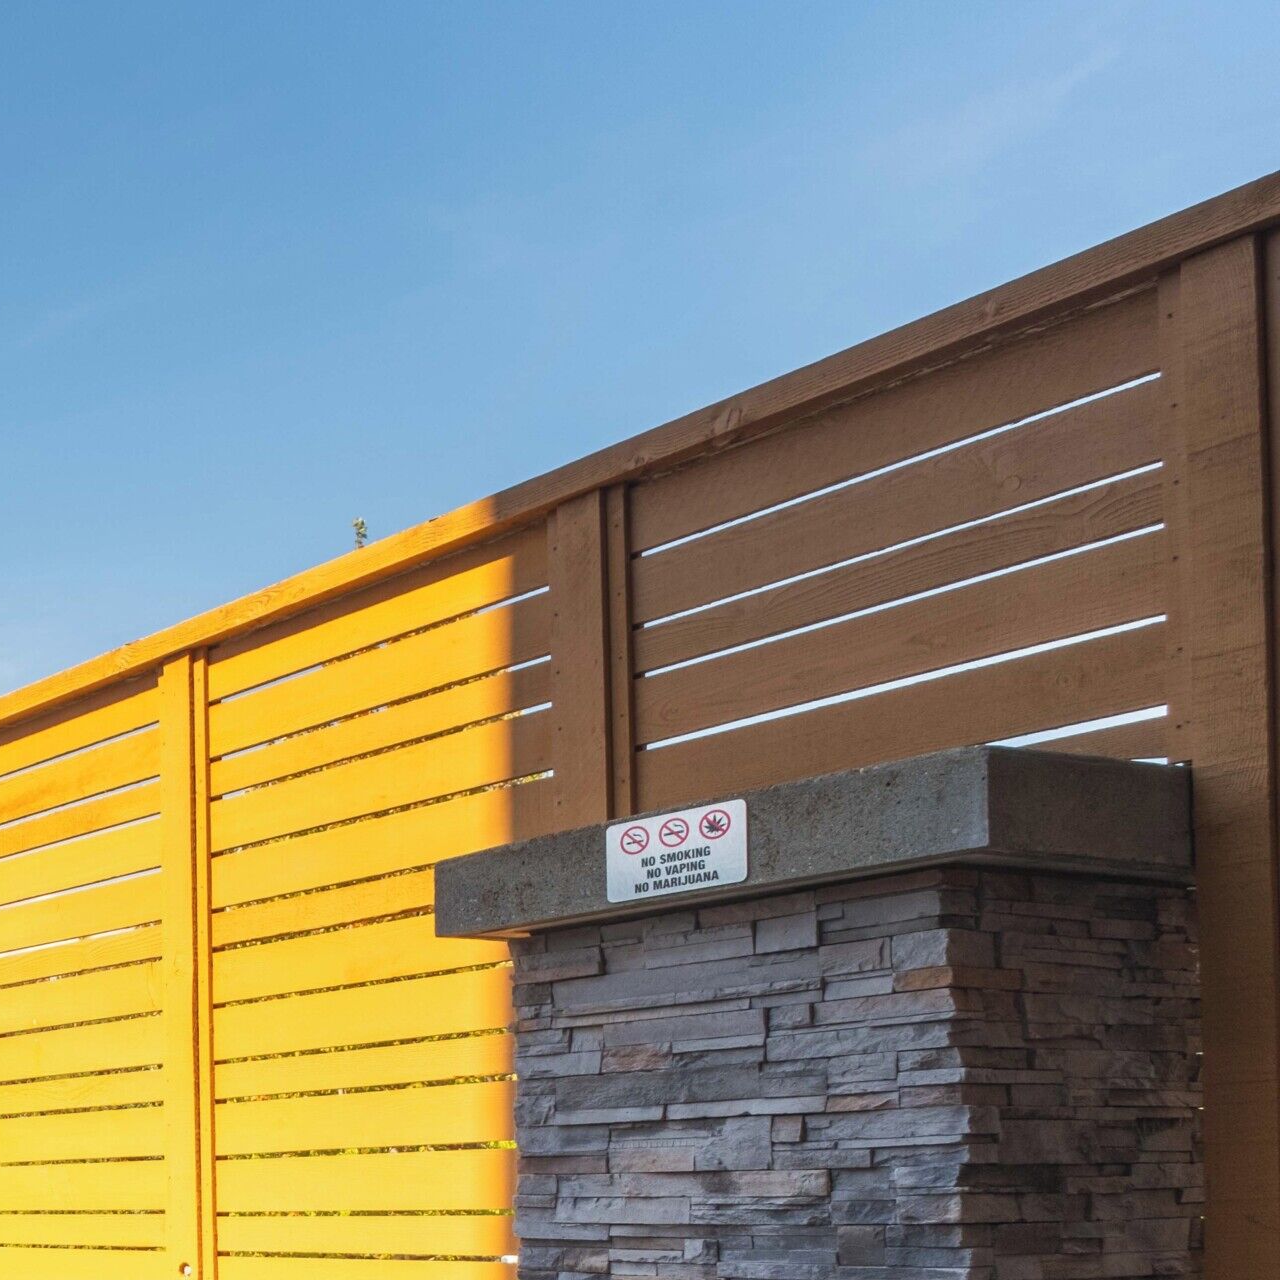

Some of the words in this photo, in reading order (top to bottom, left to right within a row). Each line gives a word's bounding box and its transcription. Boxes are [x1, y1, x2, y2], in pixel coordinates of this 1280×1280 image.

[641, 856, 656, 867] NO
[660, 846, 711, 865] SMOKING
[646, 867, 661, 879] NO
[665, 860, 705, 876] VAPING
[634, 882, 649, 893] NO
[653, 870, 719, 890] MARIJUANA
